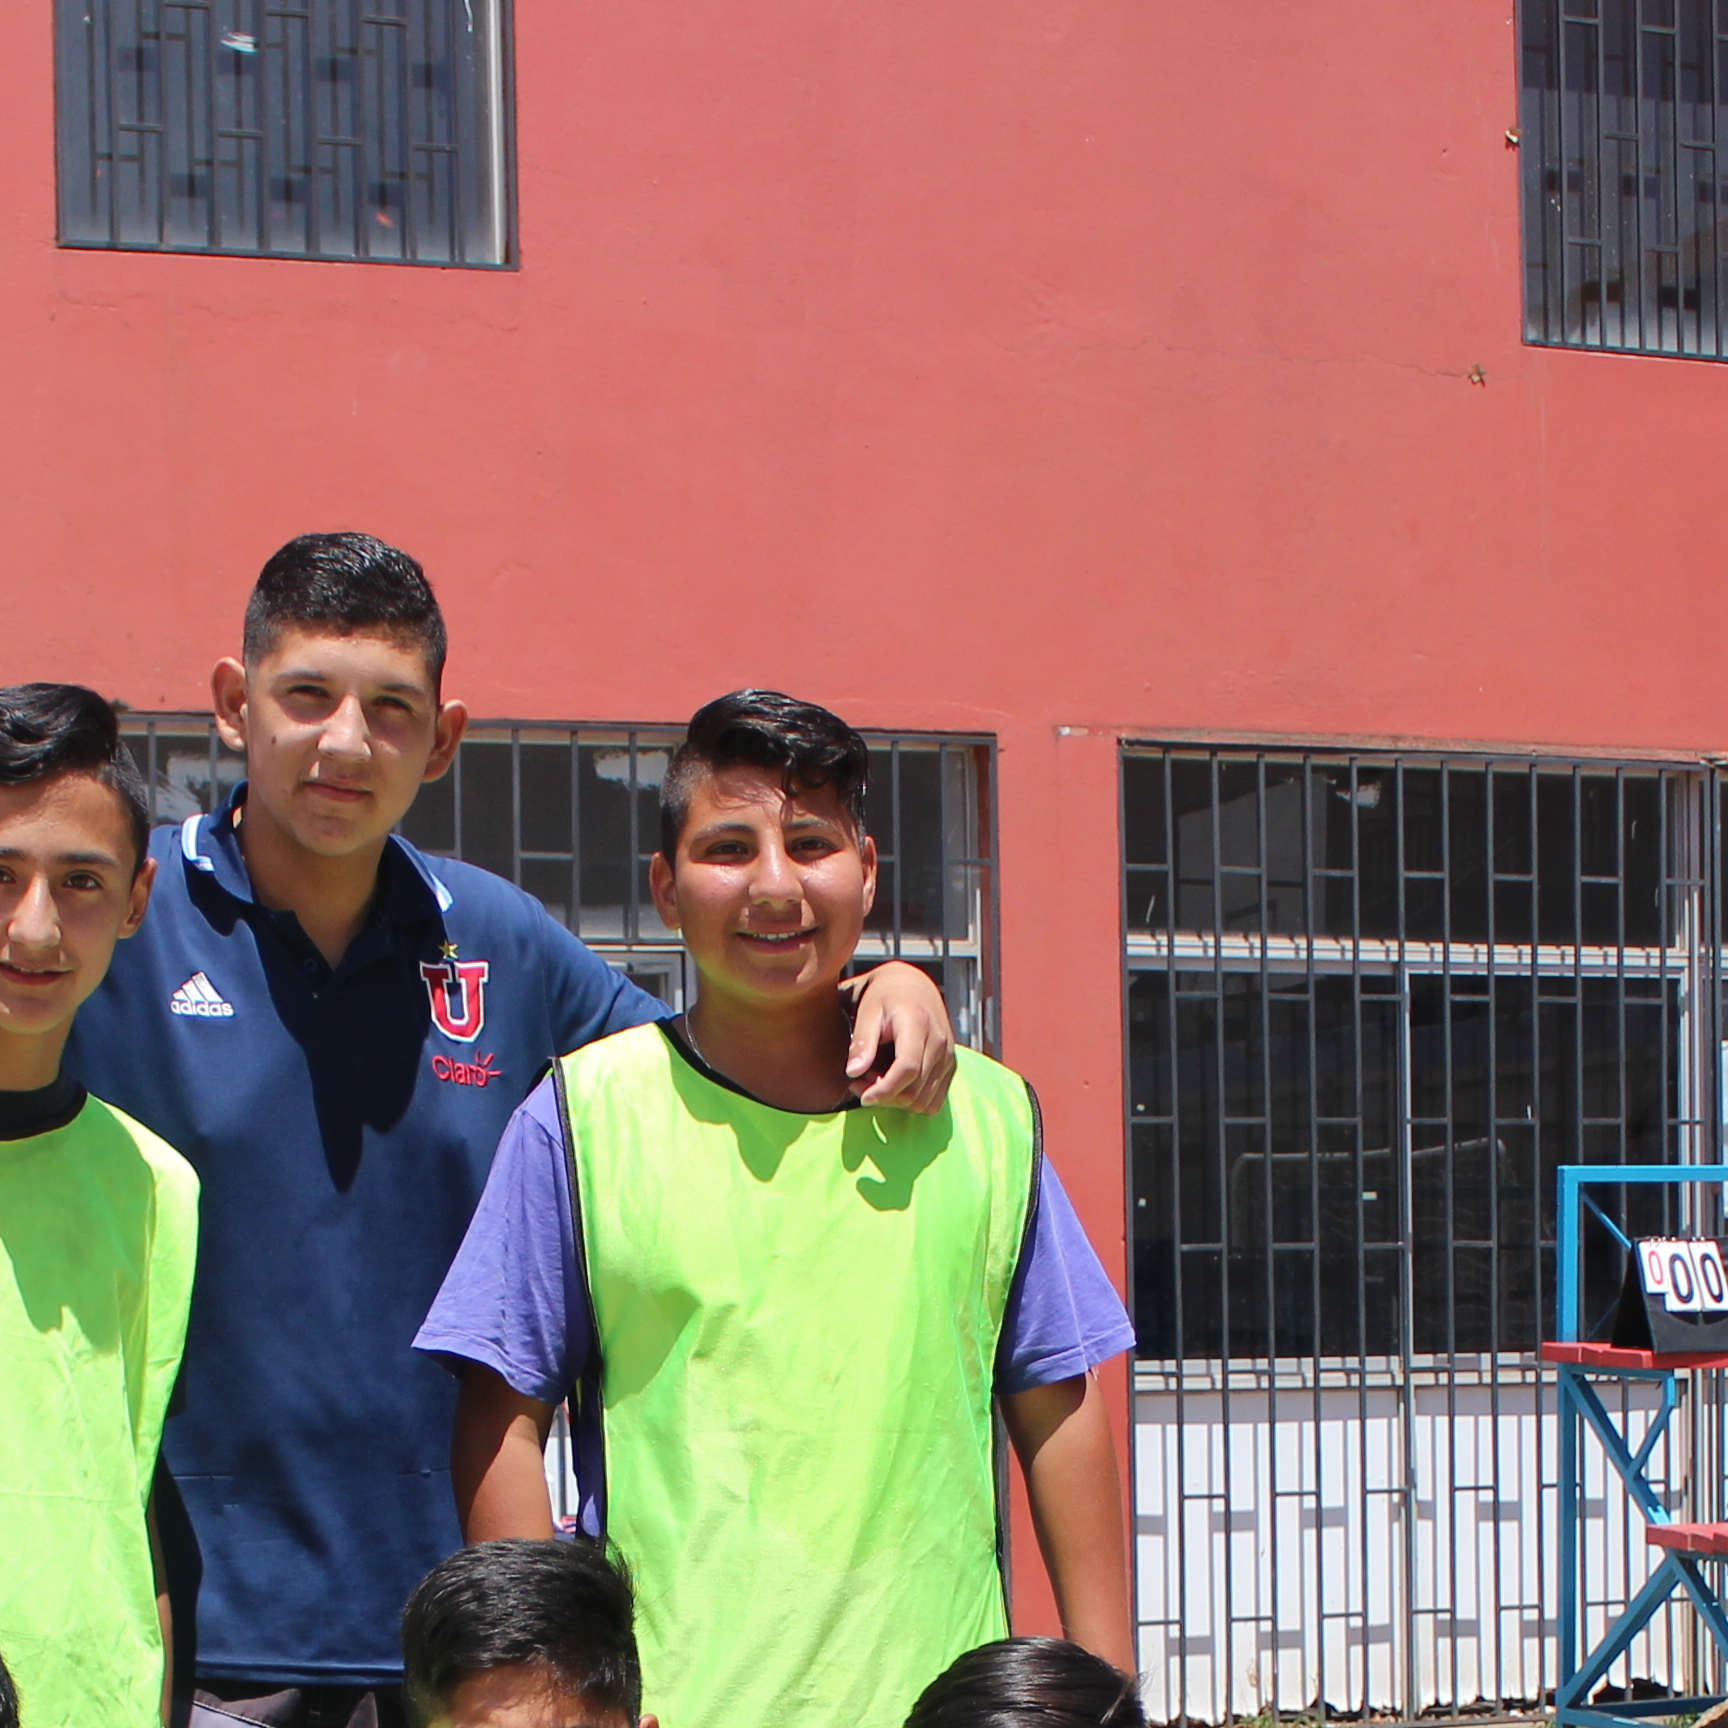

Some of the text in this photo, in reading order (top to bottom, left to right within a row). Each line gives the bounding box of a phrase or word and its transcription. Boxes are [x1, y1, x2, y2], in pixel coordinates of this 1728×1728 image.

[170, 999, 236, 1017] adidas
[419, 961, 489, 1042] U
[432, 1054, 489, 1087] Claro
